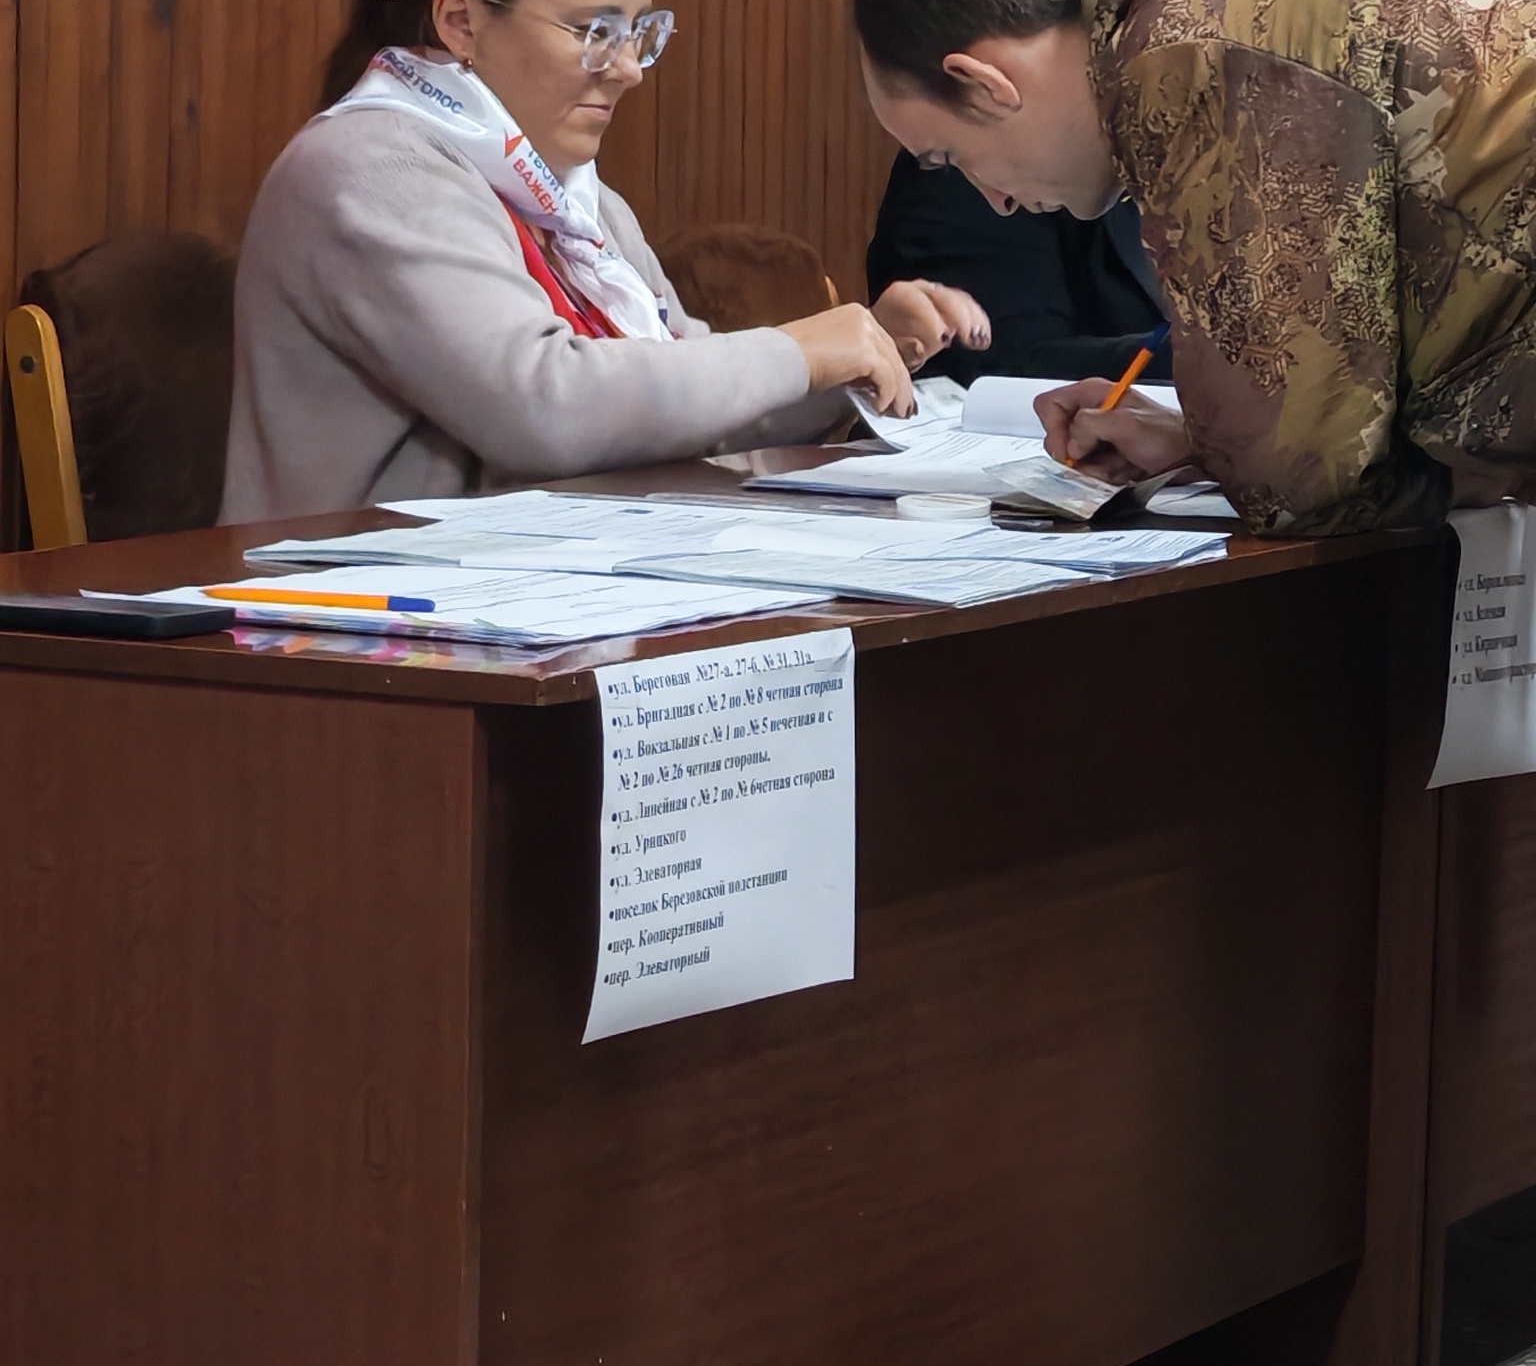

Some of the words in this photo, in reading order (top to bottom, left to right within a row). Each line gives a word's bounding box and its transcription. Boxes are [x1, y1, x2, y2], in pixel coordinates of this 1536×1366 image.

[613, 681, 631, 700] ул.
[632, 671, 691, 695] Береговая
[636, 704, 696, 729] Бригадная
[729, 696, 740, 709] по
[765, 685, 801, 702] четная
[803, 678, 843, 698] сторона
[637, 734, 700, 757] Вокзальная
[733, 726, 745, 739] по
[770, 712, 815, 732] нечетная
[635, 796, 688, 820] Линейная
[721, 788, 733, 802] по
[793, 767, 835, 788] сторона
[641, 773, 654, 787] по
[671, 763, 684, 780] 26
[686, 759, 722, 776] четная
[635, 830, 687, 855] Урицкого
[634, 857, 702, 885] Элеваторная
[614, 899, 660, 922] поселок
[661, 880, 726, 912] Березовской
[612, 938, 636, 956] пер.
[638, 910, 725, 948] Кооперативный
[609, 969, 632, 987] пер.
[635, 946, 711, 979] Элеваторный
